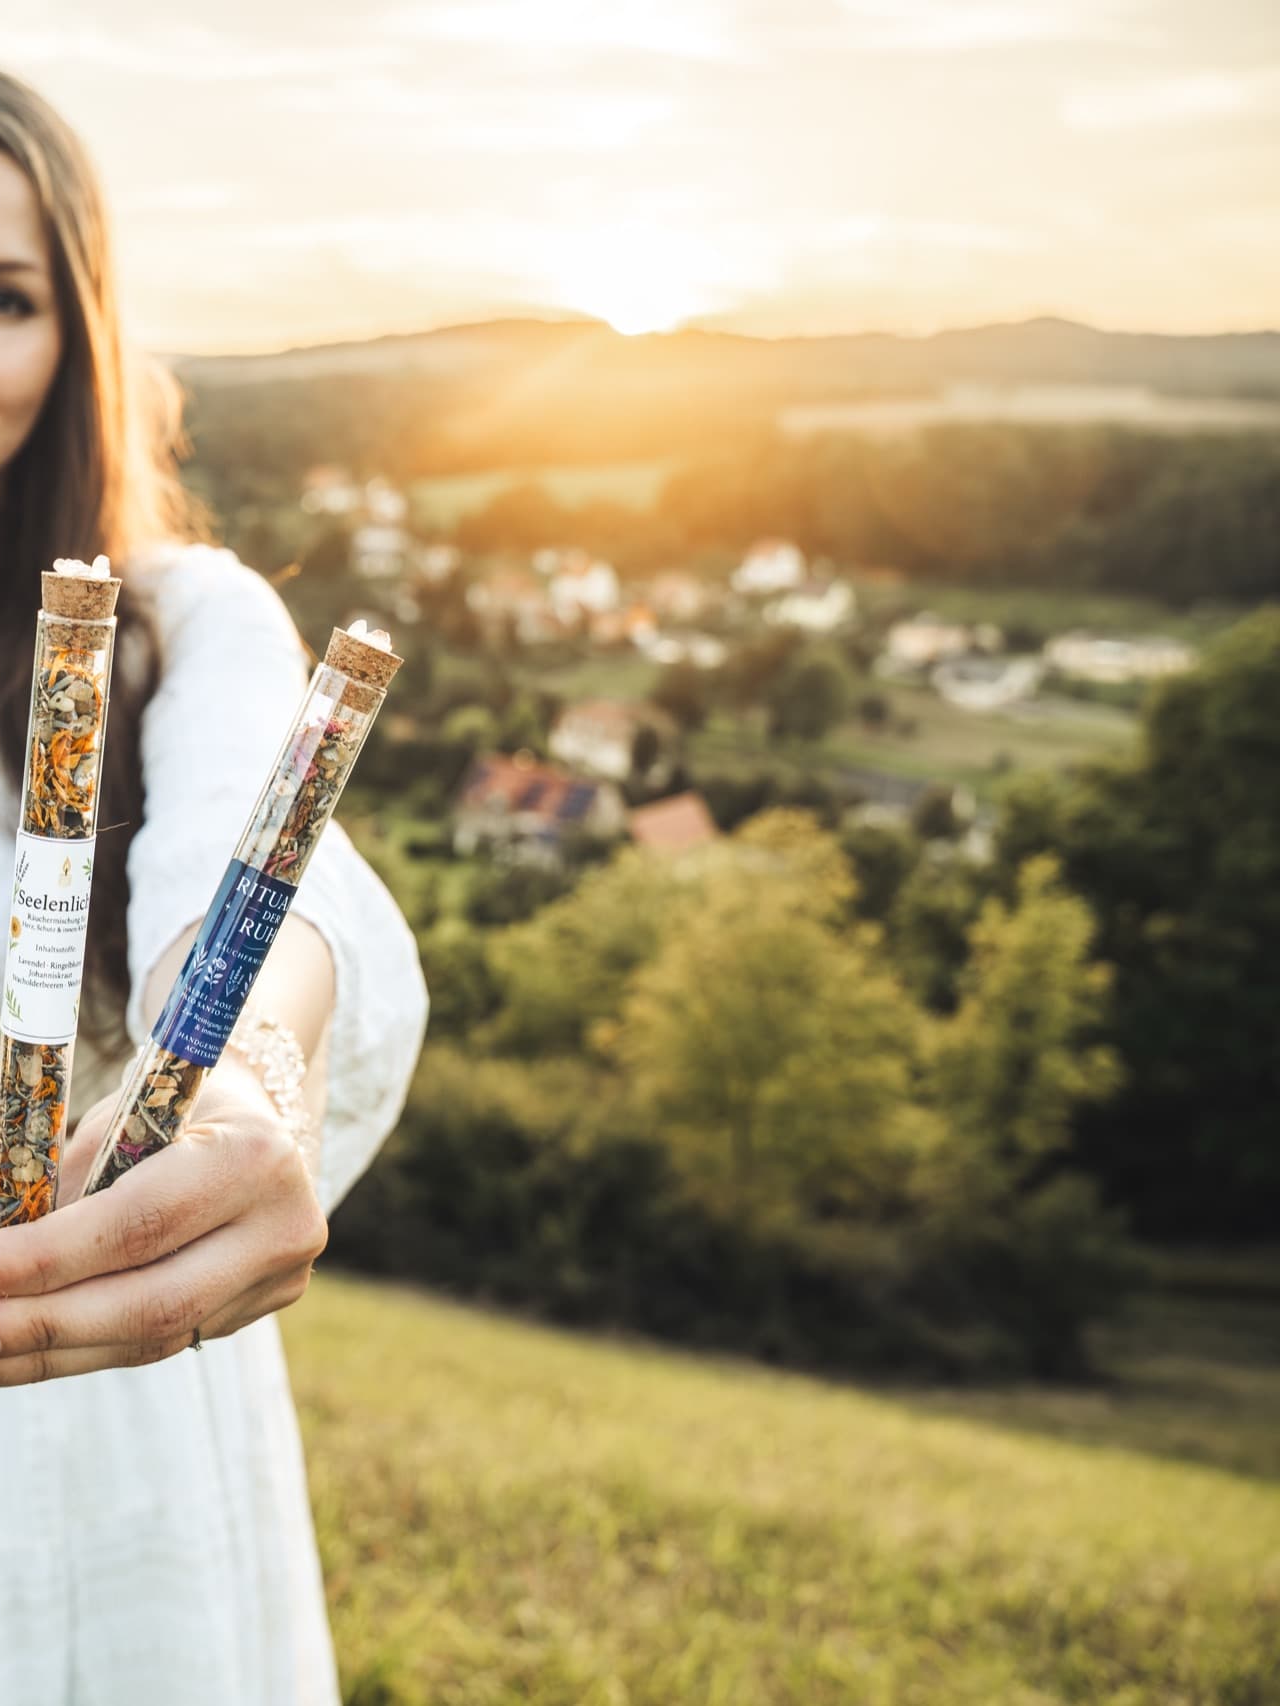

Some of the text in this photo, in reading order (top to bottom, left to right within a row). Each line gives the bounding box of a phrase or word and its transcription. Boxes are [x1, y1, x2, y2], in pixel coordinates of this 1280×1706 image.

[236, 876, 289, 911] RITUA
[239, 917, 278, 944] RUH
[262, 910, 281, 924] DER
